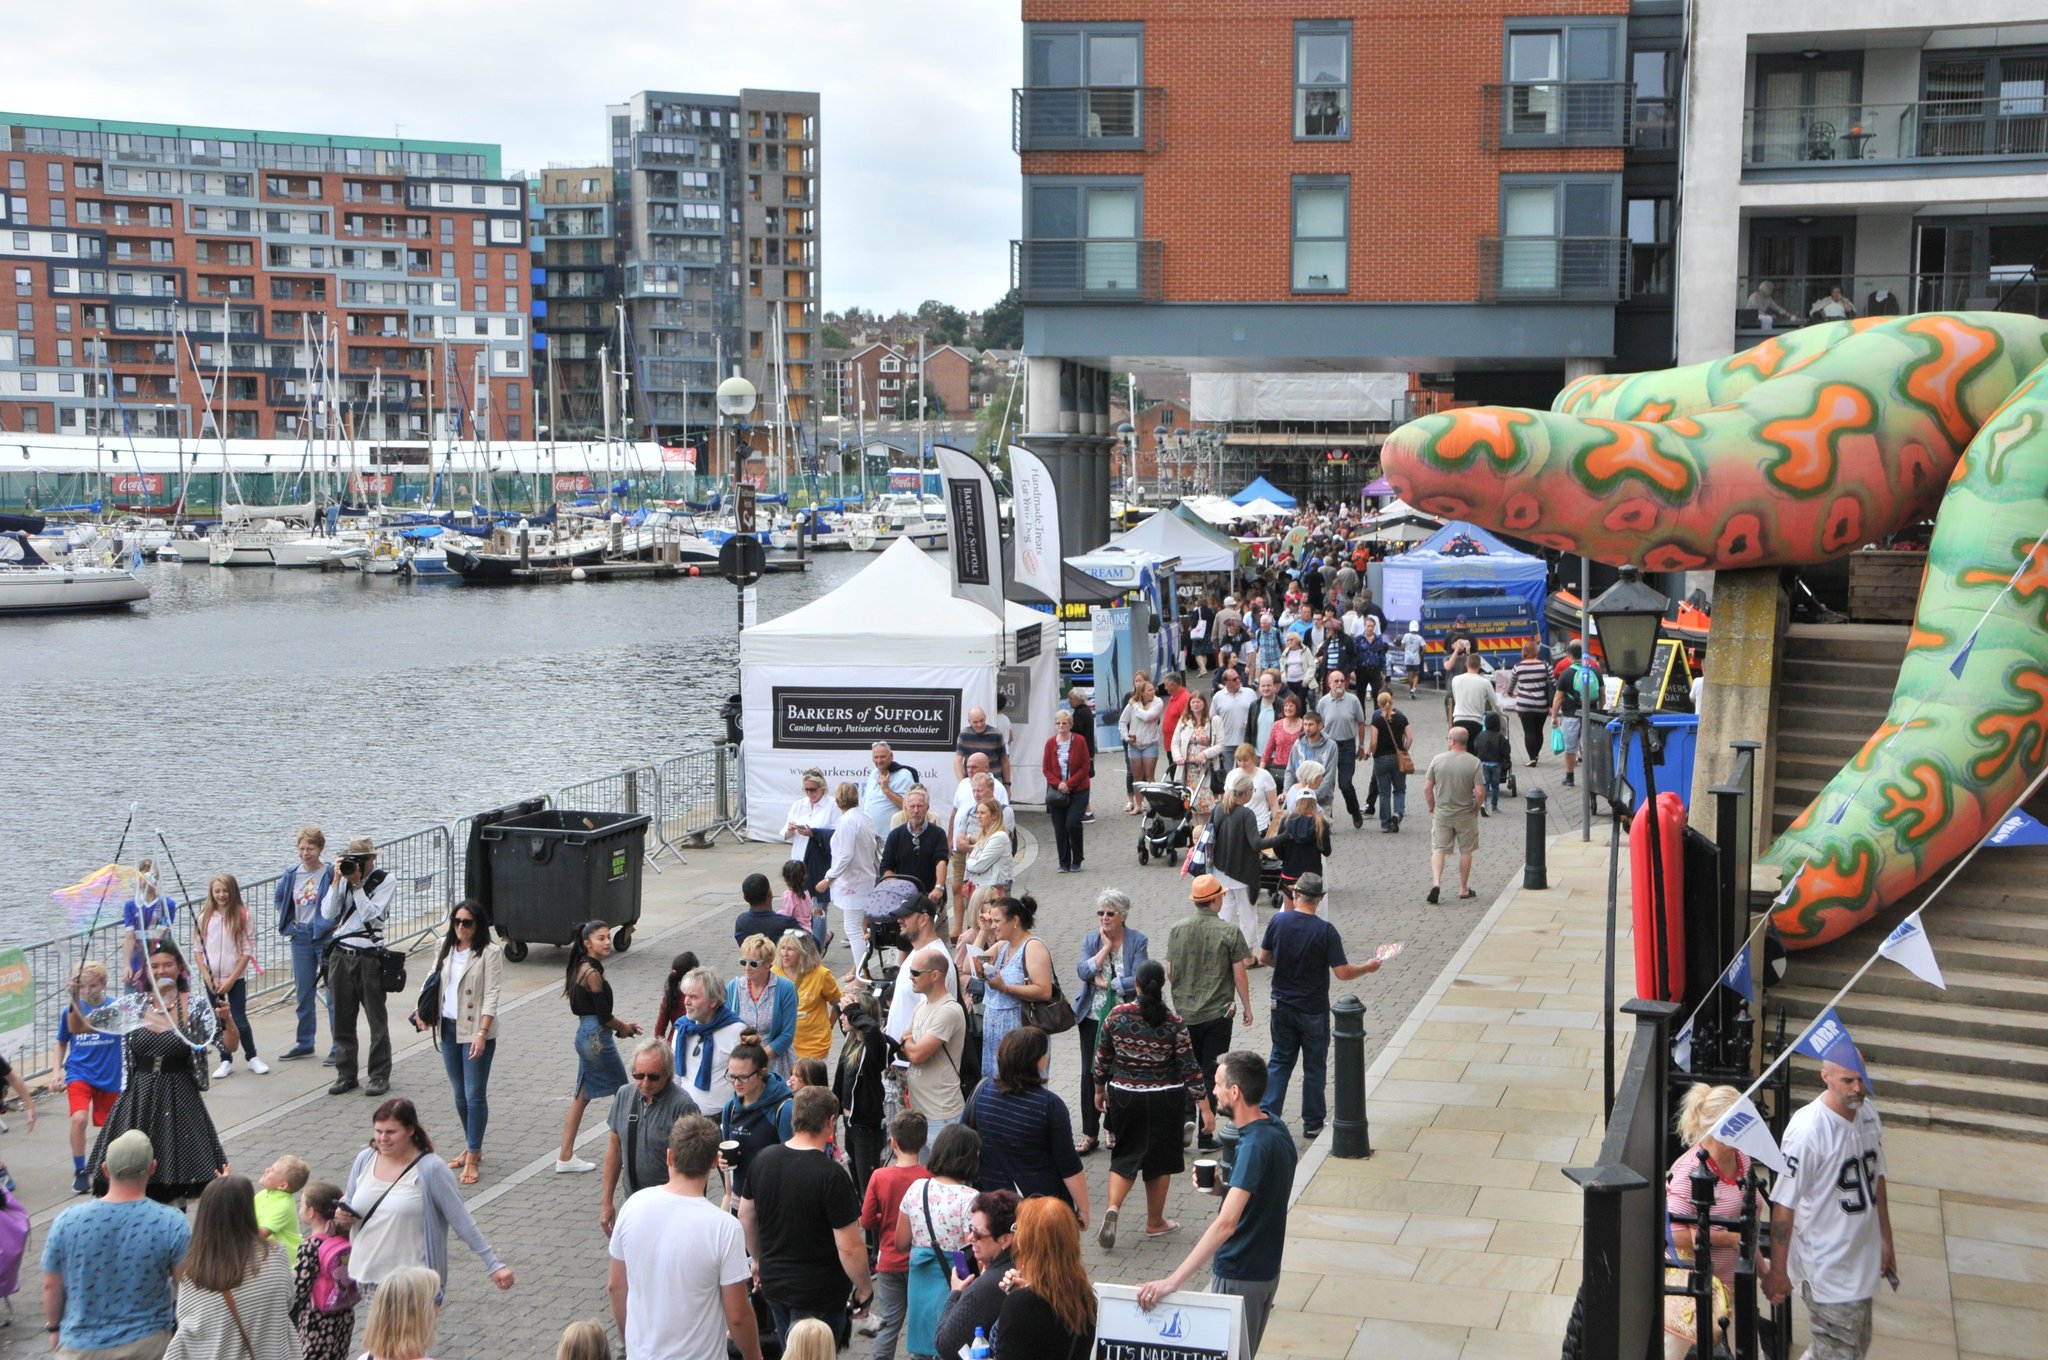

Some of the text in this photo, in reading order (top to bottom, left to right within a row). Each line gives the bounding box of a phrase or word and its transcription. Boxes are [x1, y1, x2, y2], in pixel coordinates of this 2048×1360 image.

[1022, 479, 1030, 497] For
[1023, 498, 1032, 519] Your
[1031, 468, 1044, 555] Handmade Treats
[1024, 520, 1032, 543] Dog
[787, 704, 943, 722] BARKERS of SUFFOLK
[789, 723, 940, 735] Canine Bakery, Patisserie & Chocolatier
[1809, 1020, 1840, 1054] ABP
